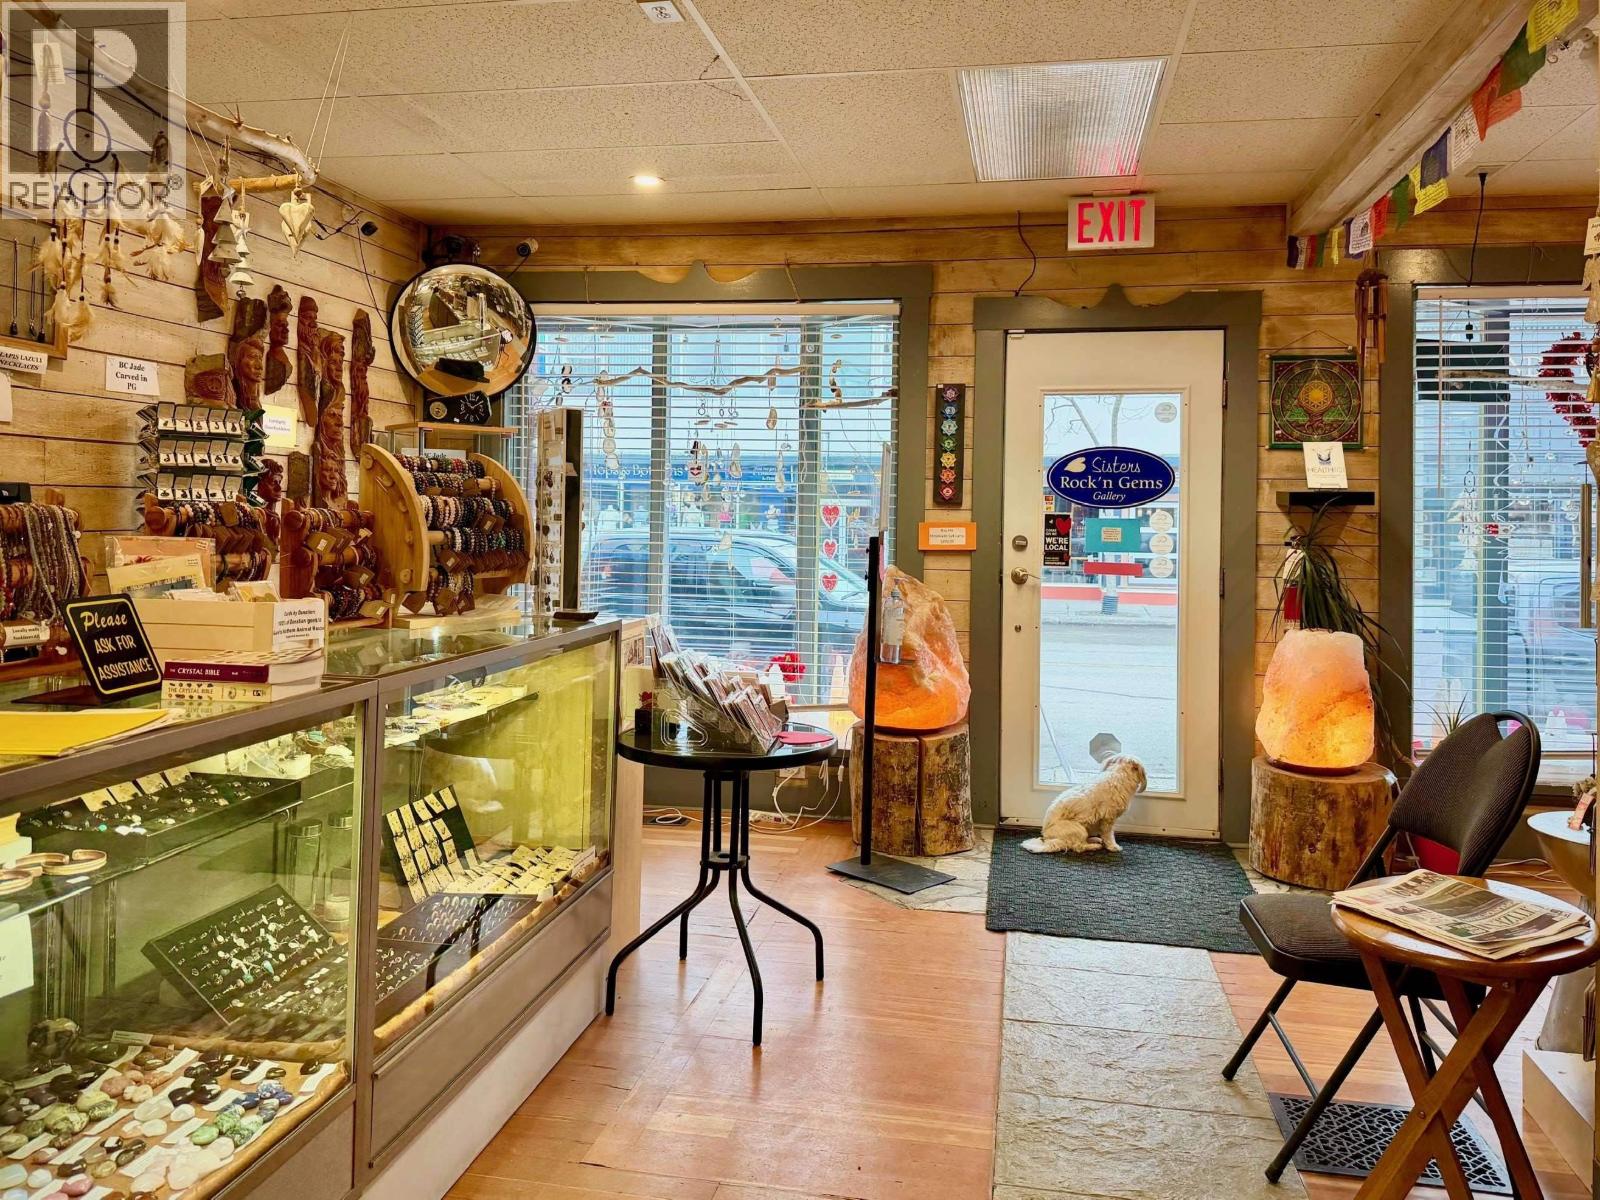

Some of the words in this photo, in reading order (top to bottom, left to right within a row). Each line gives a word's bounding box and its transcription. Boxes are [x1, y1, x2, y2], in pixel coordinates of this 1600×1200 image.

[1078, 200, 1146, 243] EXIT
[0, 352, 18, 360] LAPIS
[0, 360, 39, 370] NECKLACES
[129, 363, 145, 371] Jade
[116, 372, 139, 380] Carved
[1091, 456, 1141, 473] Sisters
[1060, 476, 1112, 488] Rock'n
[1118, 477, 1162, 489] Gems
[1093, 492, 1126, 502] Gallery
[80, 611, 127, 631] Please
[94, 637, 116, 654] ASK
[116, 634, 136, 650] FOR
[98, 658, 153, 680] ASSISTANCE
